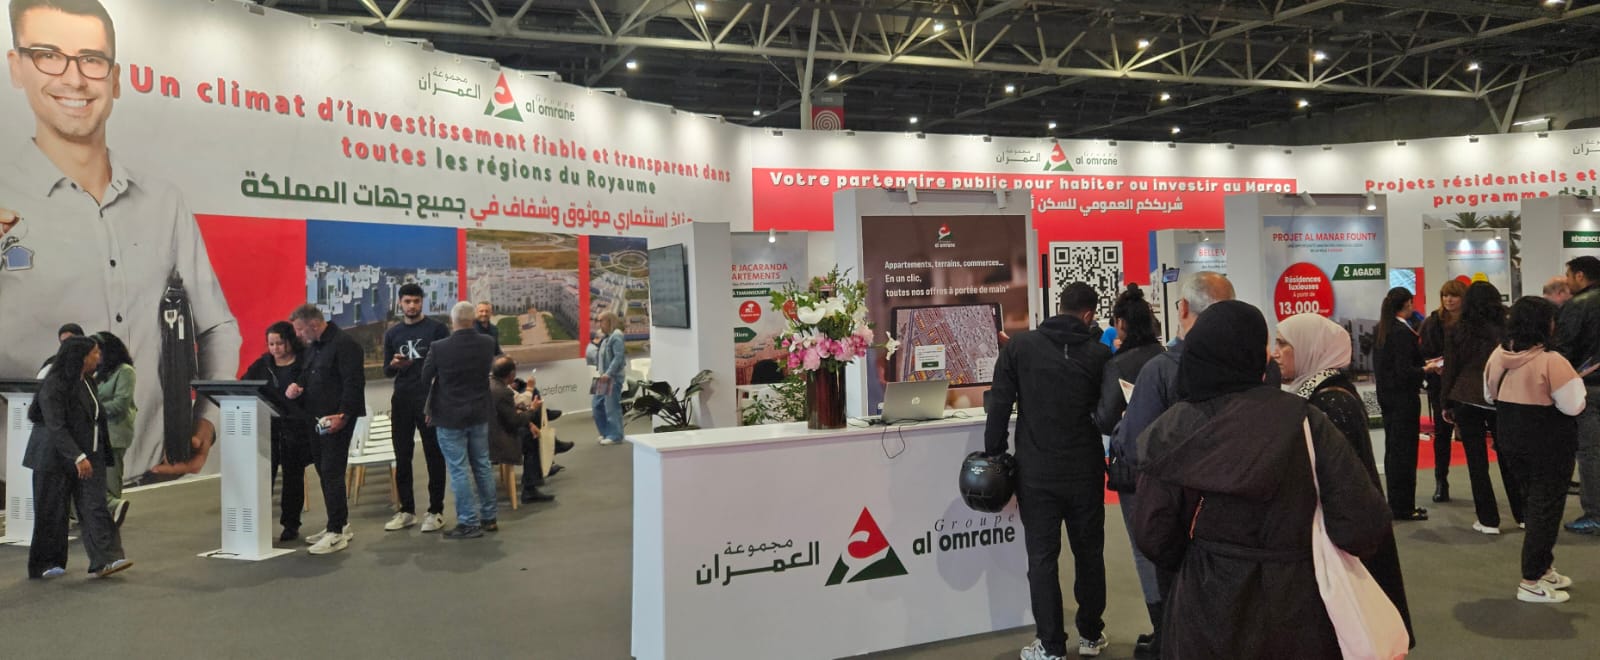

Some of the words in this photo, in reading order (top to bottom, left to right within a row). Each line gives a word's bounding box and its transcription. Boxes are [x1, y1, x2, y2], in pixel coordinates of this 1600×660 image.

[418, 73, 481, 100] العمران
[525, 100, 535, 113] al
[538, 106, 575, 122] omrane
[129, 64, 180, 98] Un
[197, 78, 305, 118] climat
[317, 97, 526, 152] d'investissement
[533, 134, 587, 161] fiable
[593, 149, 609, 165] et
[614, 150, 699, 178] transparent
[703, 164, 731, 183] dans
[341, 136, 426, 167] toutes
[436, 147, 468, 172] les
[477, 155, 552, 182] régions
[559, 166, 580, 186] du
[587, 169, 657, 194] Royaume
[1075, 156, 1083, 165] al
[1086, 157, 1118, 166] omrane
[240, 170, 347, 205] المملكة
[769, 172, 830, 186] Votre
[952, 176, 1008, 188] public
[1013, 178, 1054, 189] pour
[1059, 177, 1124, 190] habiter
[1129, 180, 1148, 191] ou
[1153, 178, 1218, 192] investir
[1223, 181, 1241, 192] au
[1245, 181, 1291, 192] Maroc
[1365, 178, 1435, 193] Projets
[1443, 169, 1568, 188] résidentiels
[1575, 169, 1597, 182] et
[353, 184, 413, 216] جهات
[417, 193, 466, 220] جميع
[1037, 197, 1077, 213] للسكن
[1080, 198, 1134, 217] العمومي
[1136, 197, 1184, 214] شريككم
[1433, 190, 1549, 208] programme
[470, 194, 499, 228] في
[503, 195, 560, 226] وشفاف
[562, 201, 611, 229] موثوق
[613, 206, 668, 235] استثماري
[1272, 233, 1303, 241] PROJET
[1304, 233, 1314, 241] AL
[1315, 233, 1345, 241] MANAR
[1346, 233, 1377, 241] FOUNTY
[739, 263, 788, 271] JACARANDA
[884, 261, 934, 270] Appartements,
[934, 260, 962, 268] terrains,
[1352, 267, 1382, 277] AGADIR
[885, 274, 895, 283] En
[906, 273, 922, 283] clic,
[885, 289, 910, 297] toutes
[925, 287, 949, 296] offres
[949, 286, 954, 295] à
[954, 285, 977, 296] portée
[979, 285, 988, 294] de
[1279, 301, 1320, 315] 13.000
[541, 384, 578, 397] lateforme
[934, 512, 1014, 533] Groupe
[724, 537, 794, 557] مجموعة
[912, 531, 931, 555] al
[939, 524, 1015, 551] omrane
[695, 541, 820, 586] العمران
